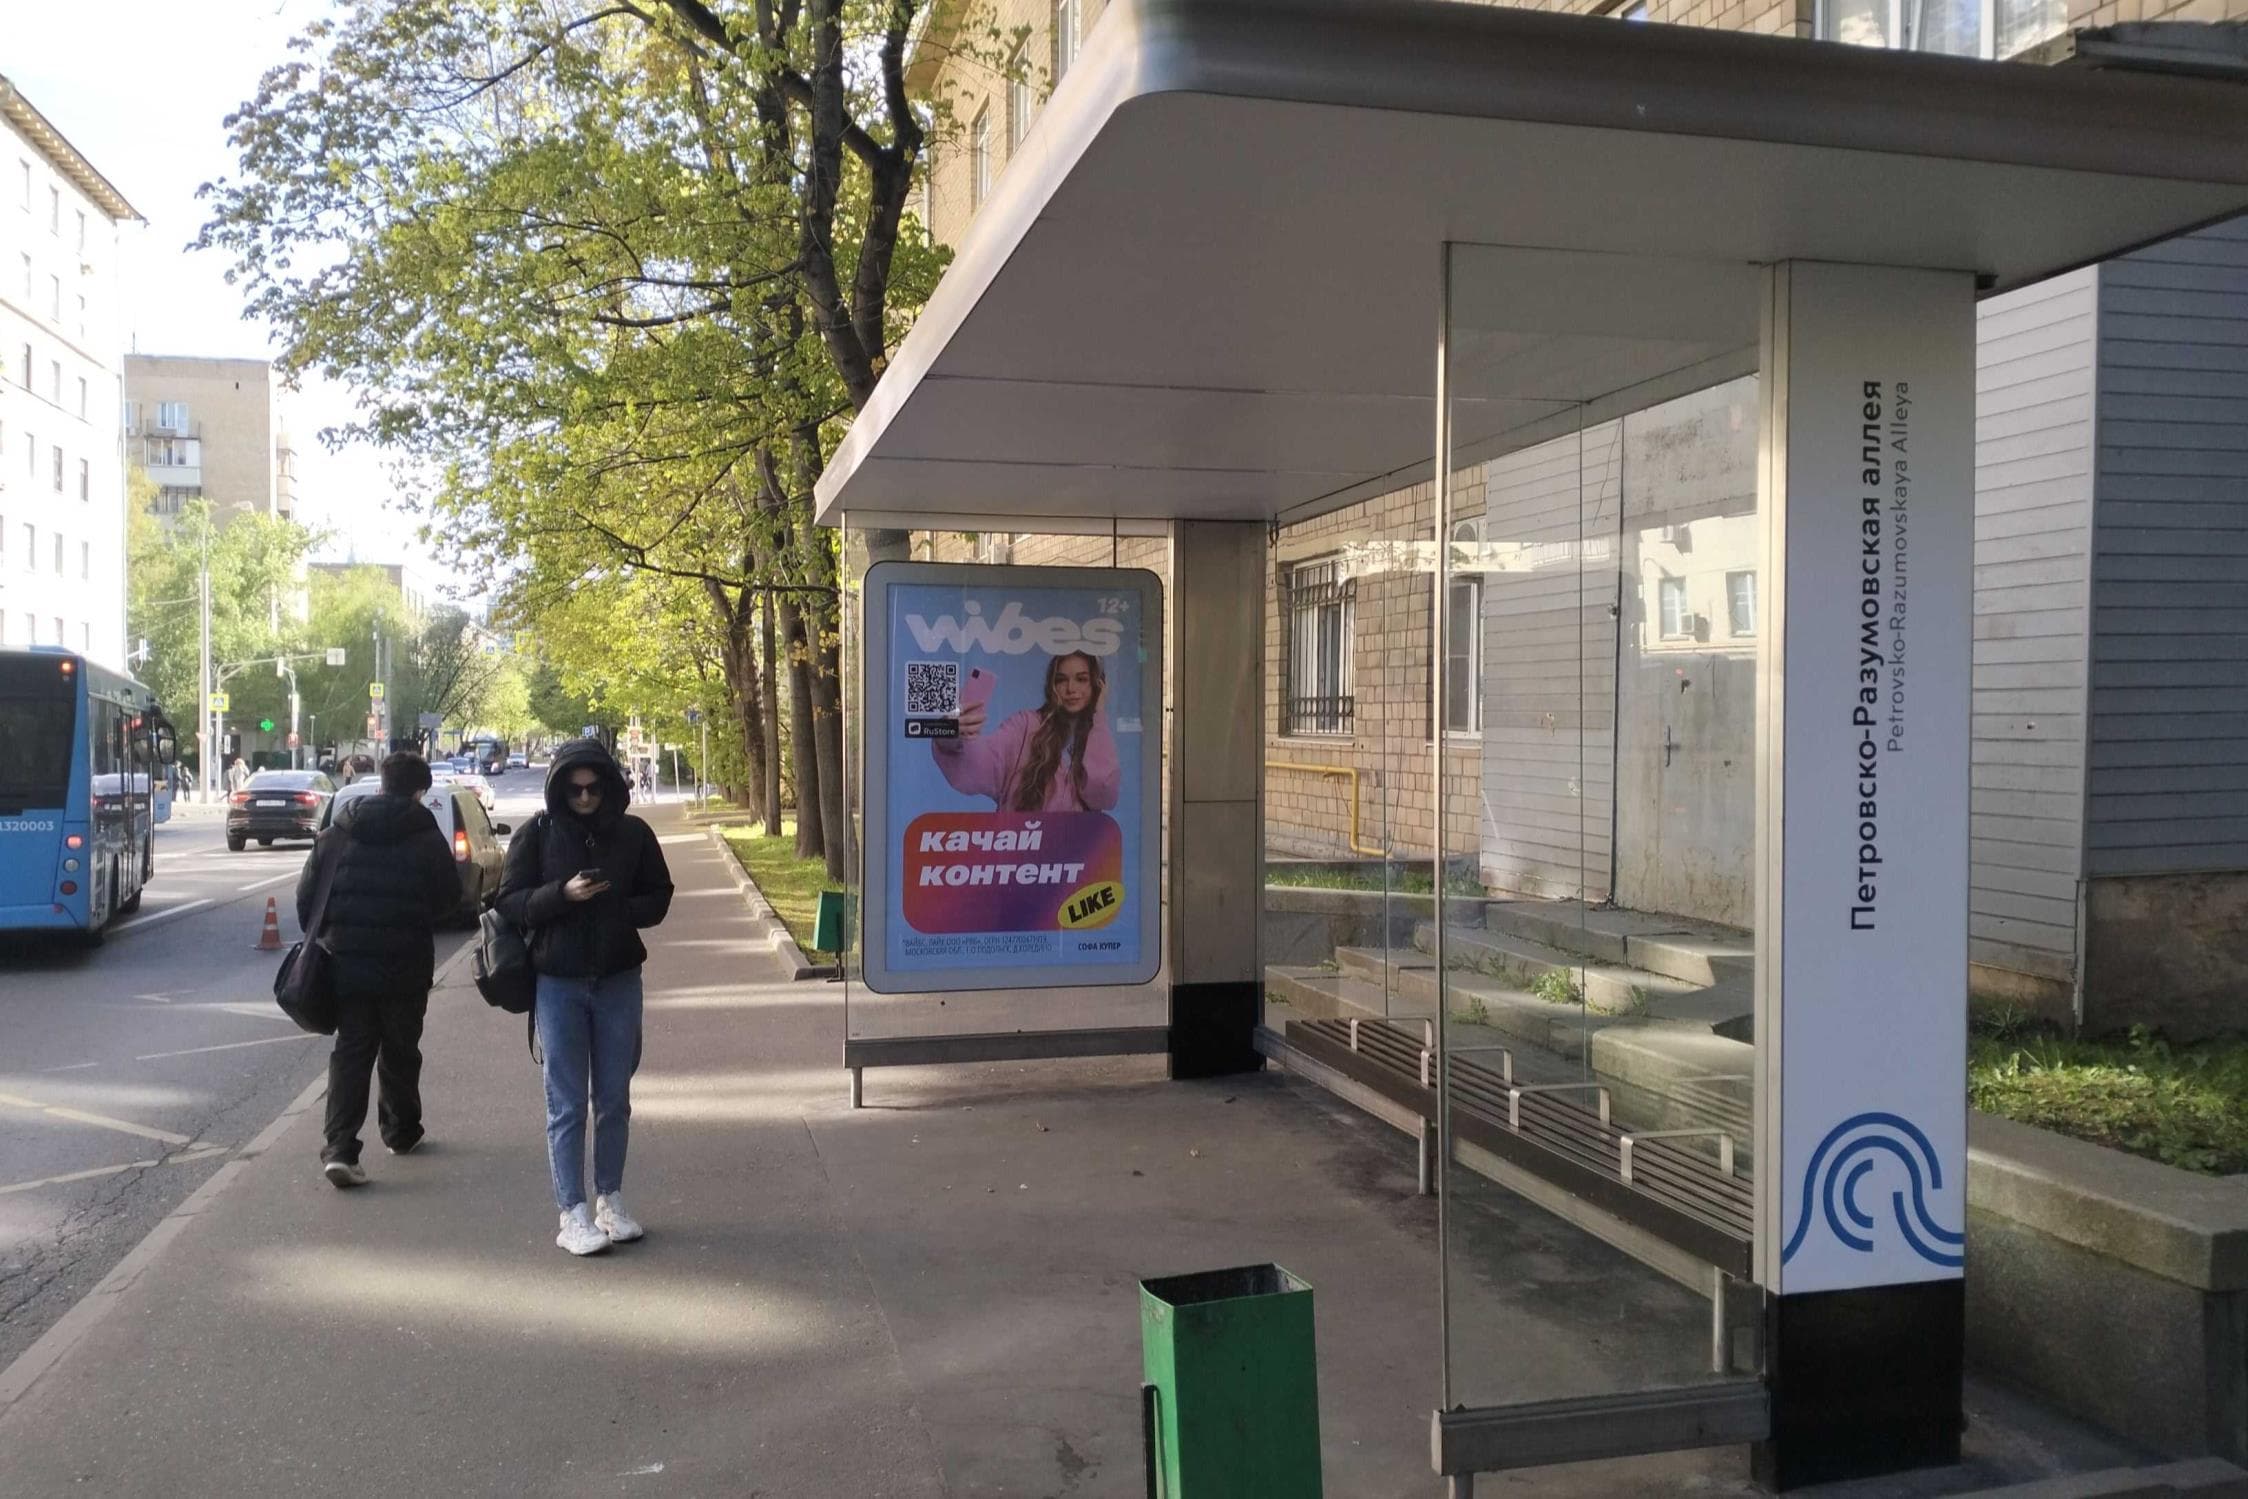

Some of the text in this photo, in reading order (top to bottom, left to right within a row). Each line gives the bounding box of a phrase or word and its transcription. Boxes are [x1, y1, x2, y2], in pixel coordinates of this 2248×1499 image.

[1887, 381, 1913, 752] Petrovsko-Razumovskaya Alleya
[1097, 597, 1130, 614] 12+
[1851, 380, 1884, 931] Петровско-Разумовская аллея
[923, 727, 956, 736] RuStore
[919, 820, 1043, 852] качай
[919, 863, 1085, 887] контент
[1067, 886, 1116, 924] LIKE
